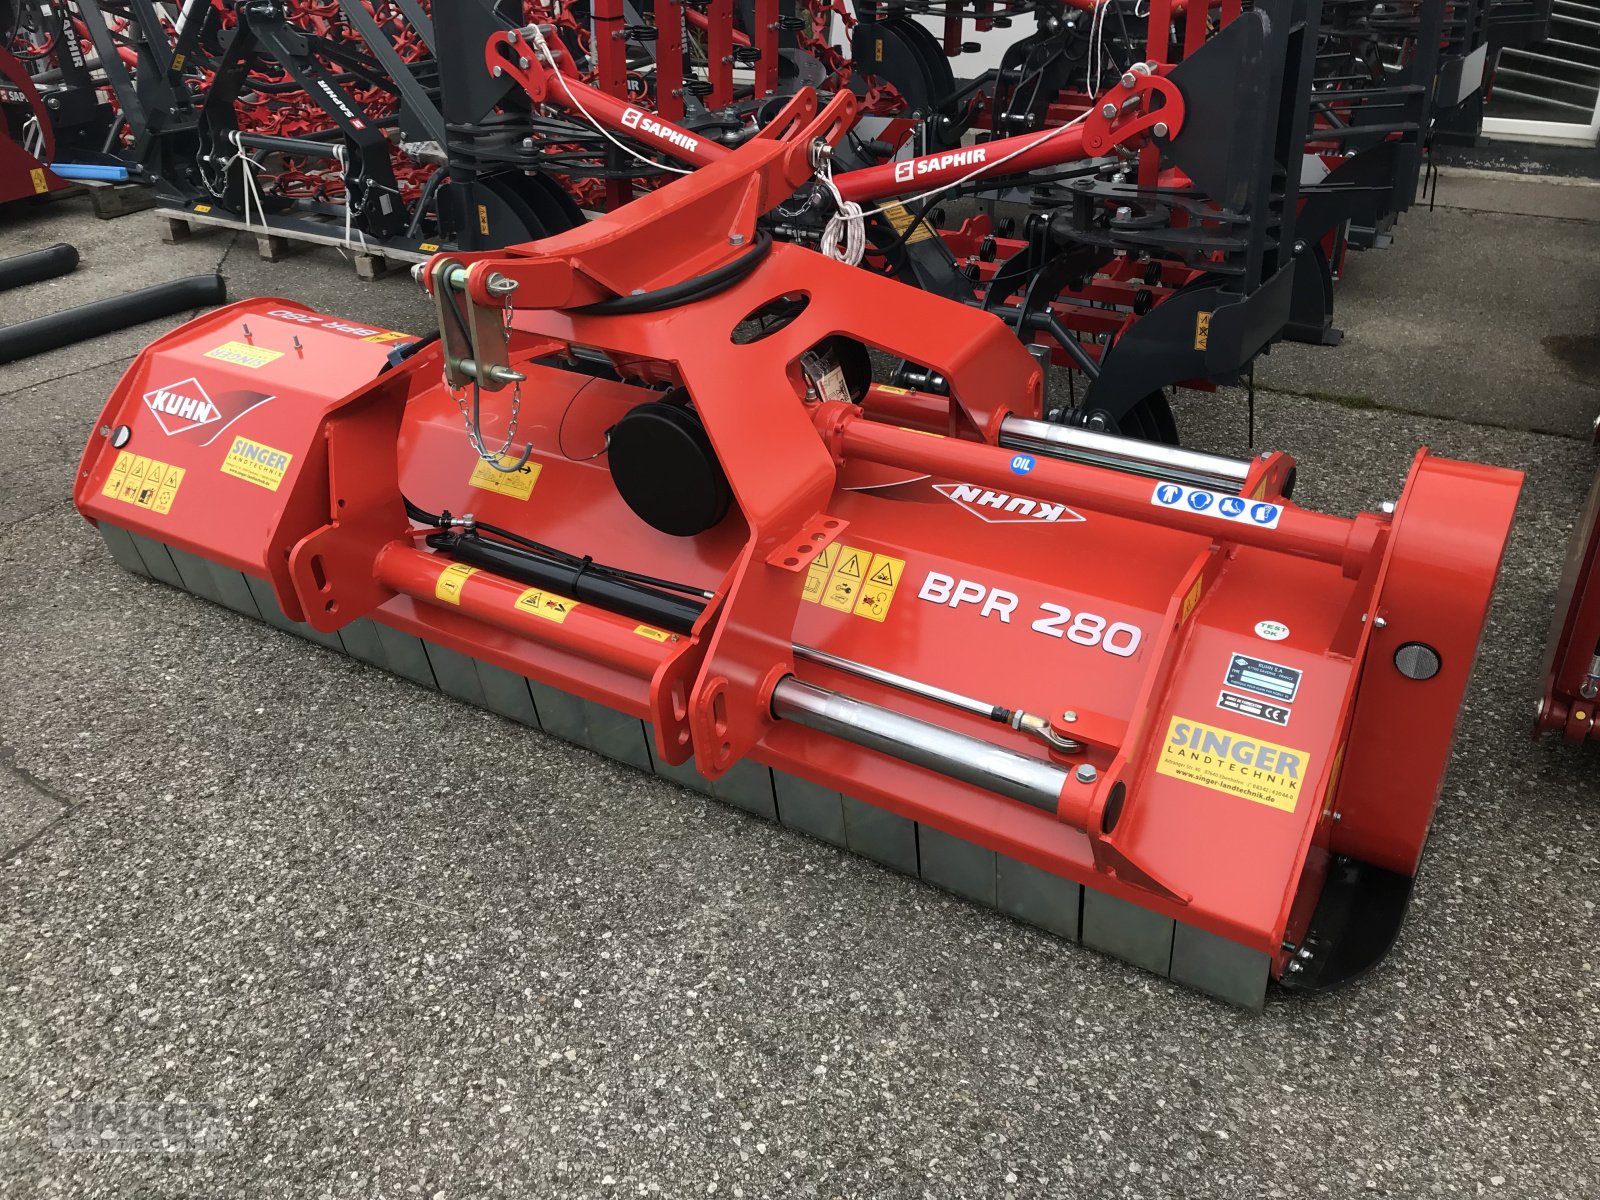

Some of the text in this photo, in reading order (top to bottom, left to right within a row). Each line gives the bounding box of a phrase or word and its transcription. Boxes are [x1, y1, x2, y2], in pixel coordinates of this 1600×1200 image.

[8, 90, 30, 103] SAP
[317, 80, 355, 118] SAPHIR
[640, 118, 699, 153] SAPHIR
[917, 148, 986, 175] SAPHIR
[266, 309, 381, 337] BPR 280
[151, 389, 212, 423] KUHN
[232, 439, 288, 472] SINGER
[1012, 456, 1031, 471] OIL
[949, 484, 1067, 522] KUHN
[917, 570, 1020, 624] BPR
[1030, 601, 1142, 658] 280
[1260, 622, 1287, 633] TEST
[1263, 629, 1277, 637] OK
[1265, 707, 1281, 720] CE
[1167, 745, 1298, 790] LANDTECHNIK
[1171, 723, 1300, 779] SINGER
[1175, 768, 1276, 803] www.singer-landtechnik.de
